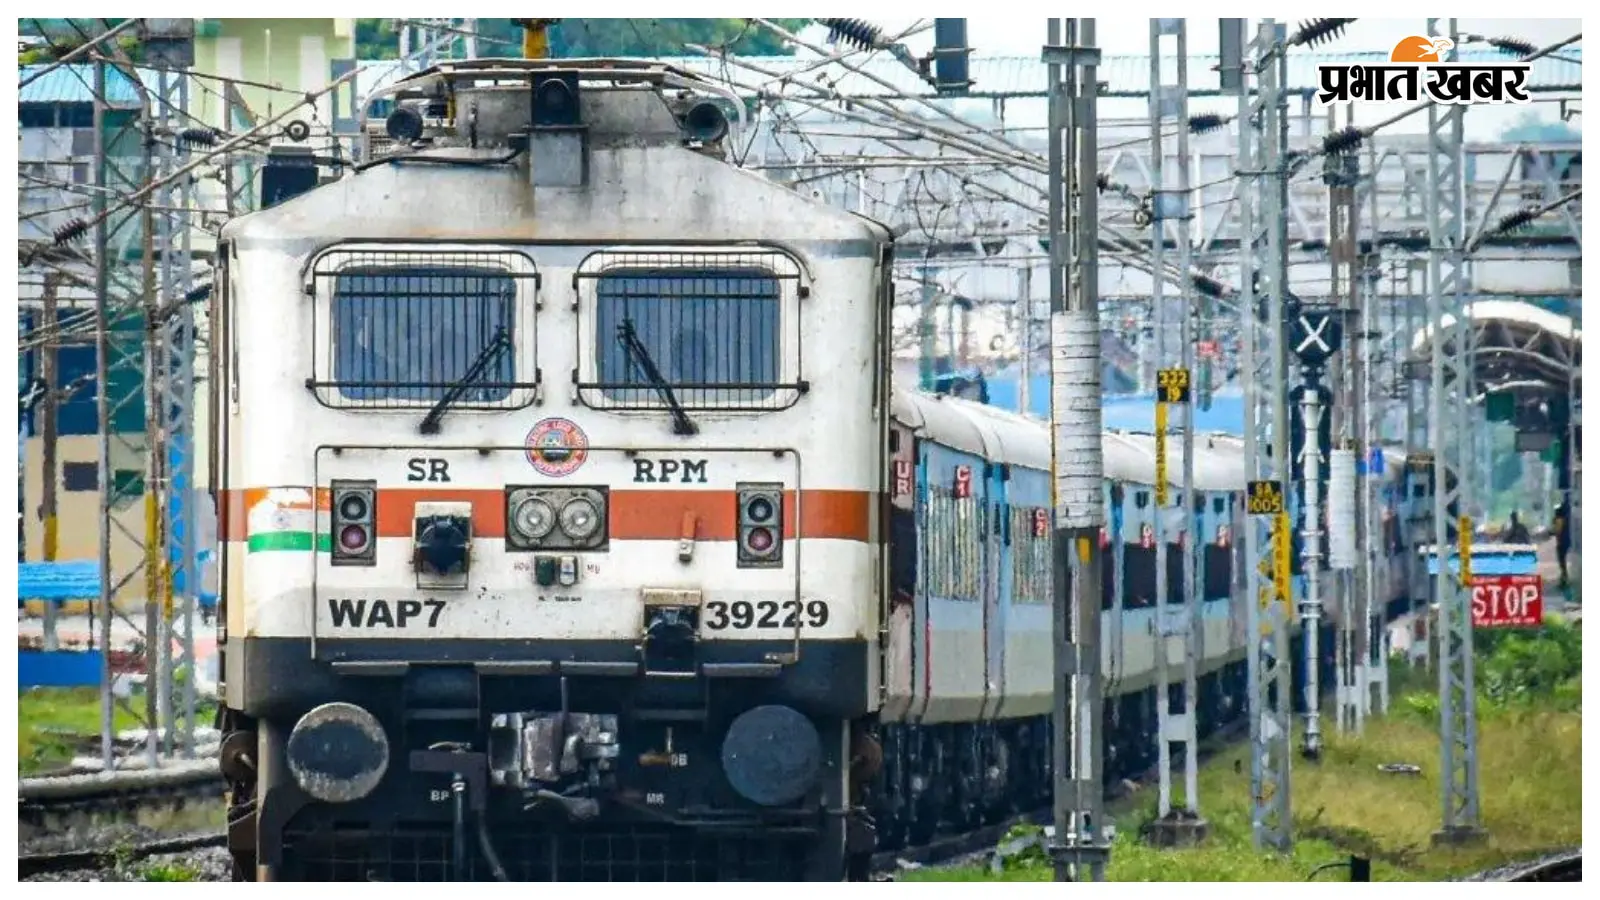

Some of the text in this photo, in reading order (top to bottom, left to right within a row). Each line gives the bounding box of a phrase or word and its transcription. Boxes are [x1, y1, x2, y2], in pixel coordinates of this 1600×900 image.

[407, 458, 451, 482] SR
[633, 458, 709, 483] RPM
[896, 462, 911, 494] UR
[328, 598, 447, 628] WAP7
[706, 600, 829, 629] 39229
[1472, 584, 1539, 618] STOP
[431, 790, 450, 801] BP
